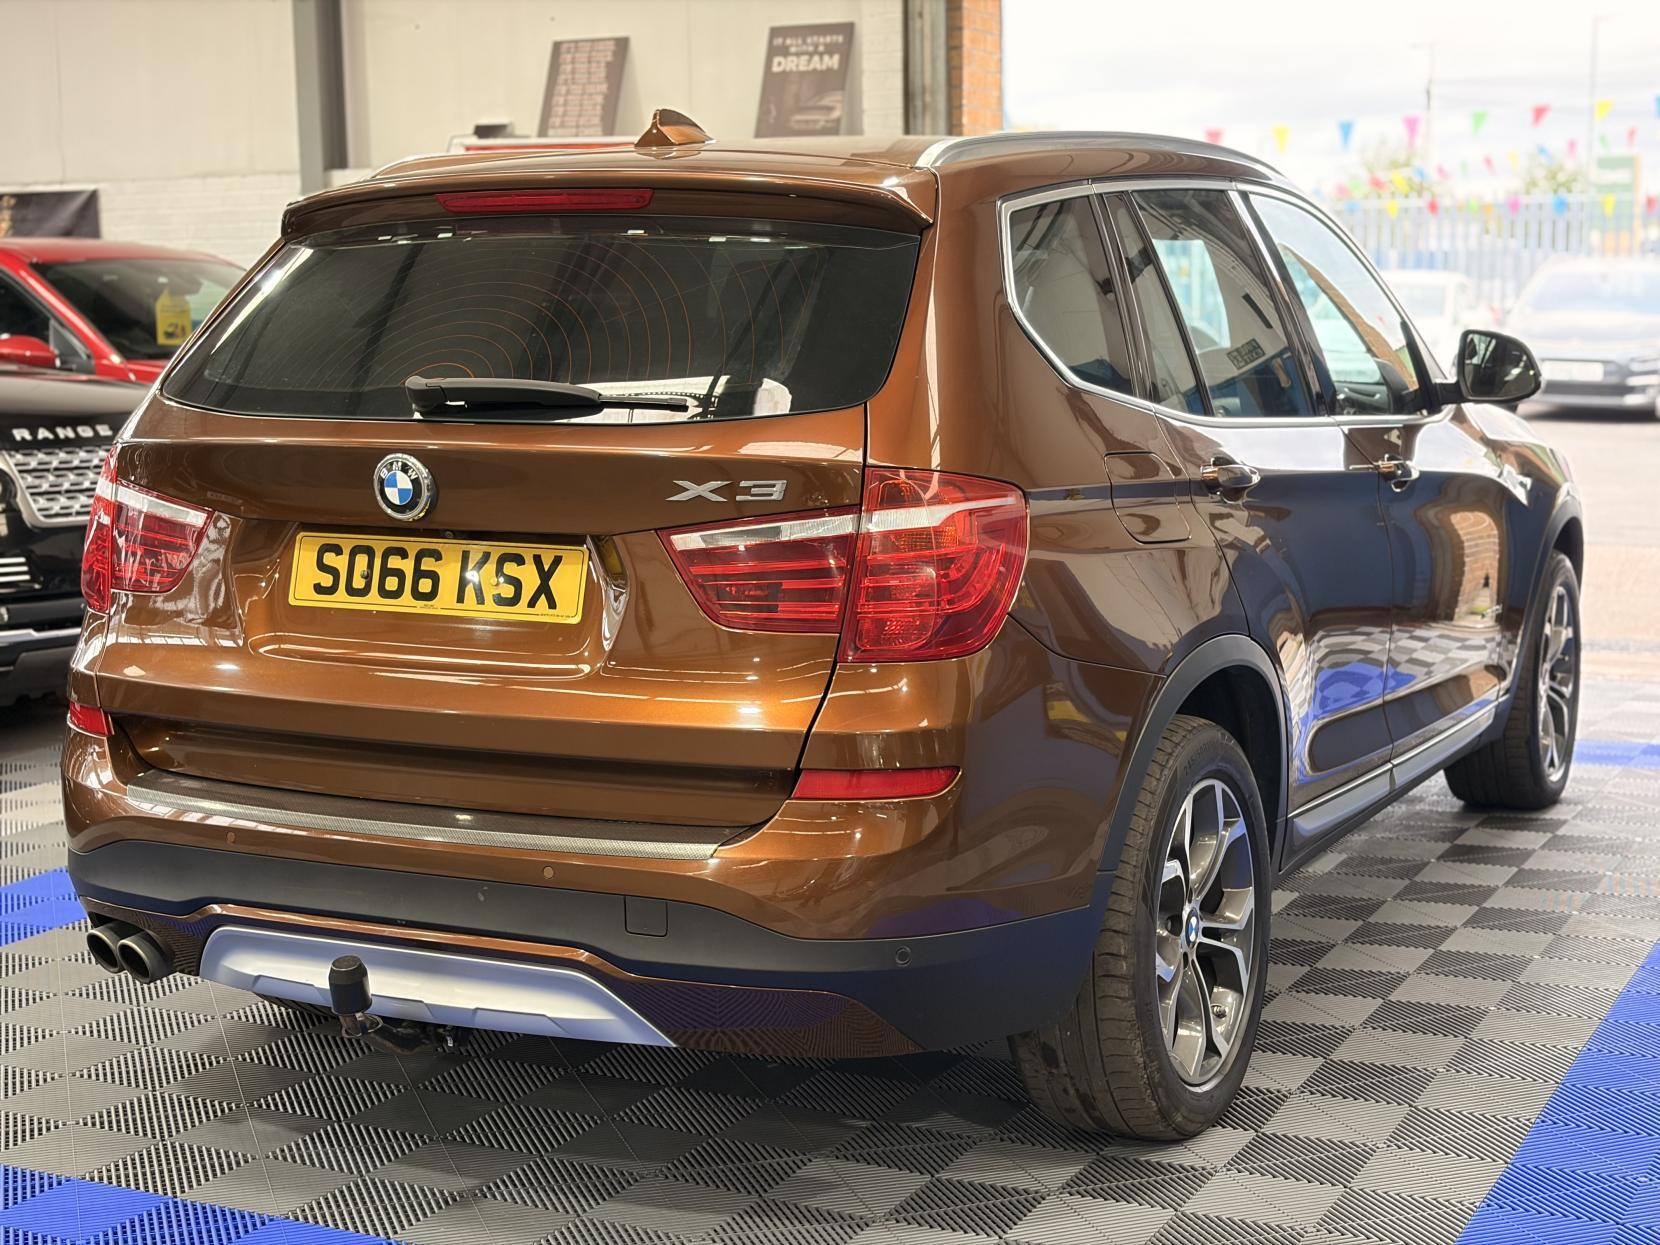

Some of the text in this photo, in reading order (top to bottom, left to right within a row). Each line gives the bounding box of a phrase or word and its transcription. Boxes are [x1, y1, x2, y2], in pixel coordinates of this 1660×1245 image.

[785, 36, 803, 46] ALL
[806, 34, 844, 44] STARTS
[789, 44, 825, 53] WITH A
[771, 53, 840, 73] DREAM
[12, 424, 113, 442] RANGE
[380, 461, 418, 480] BMW
[666, 479, 787, 503] X3
[312, 543, 563, 611] SO66 KSX
